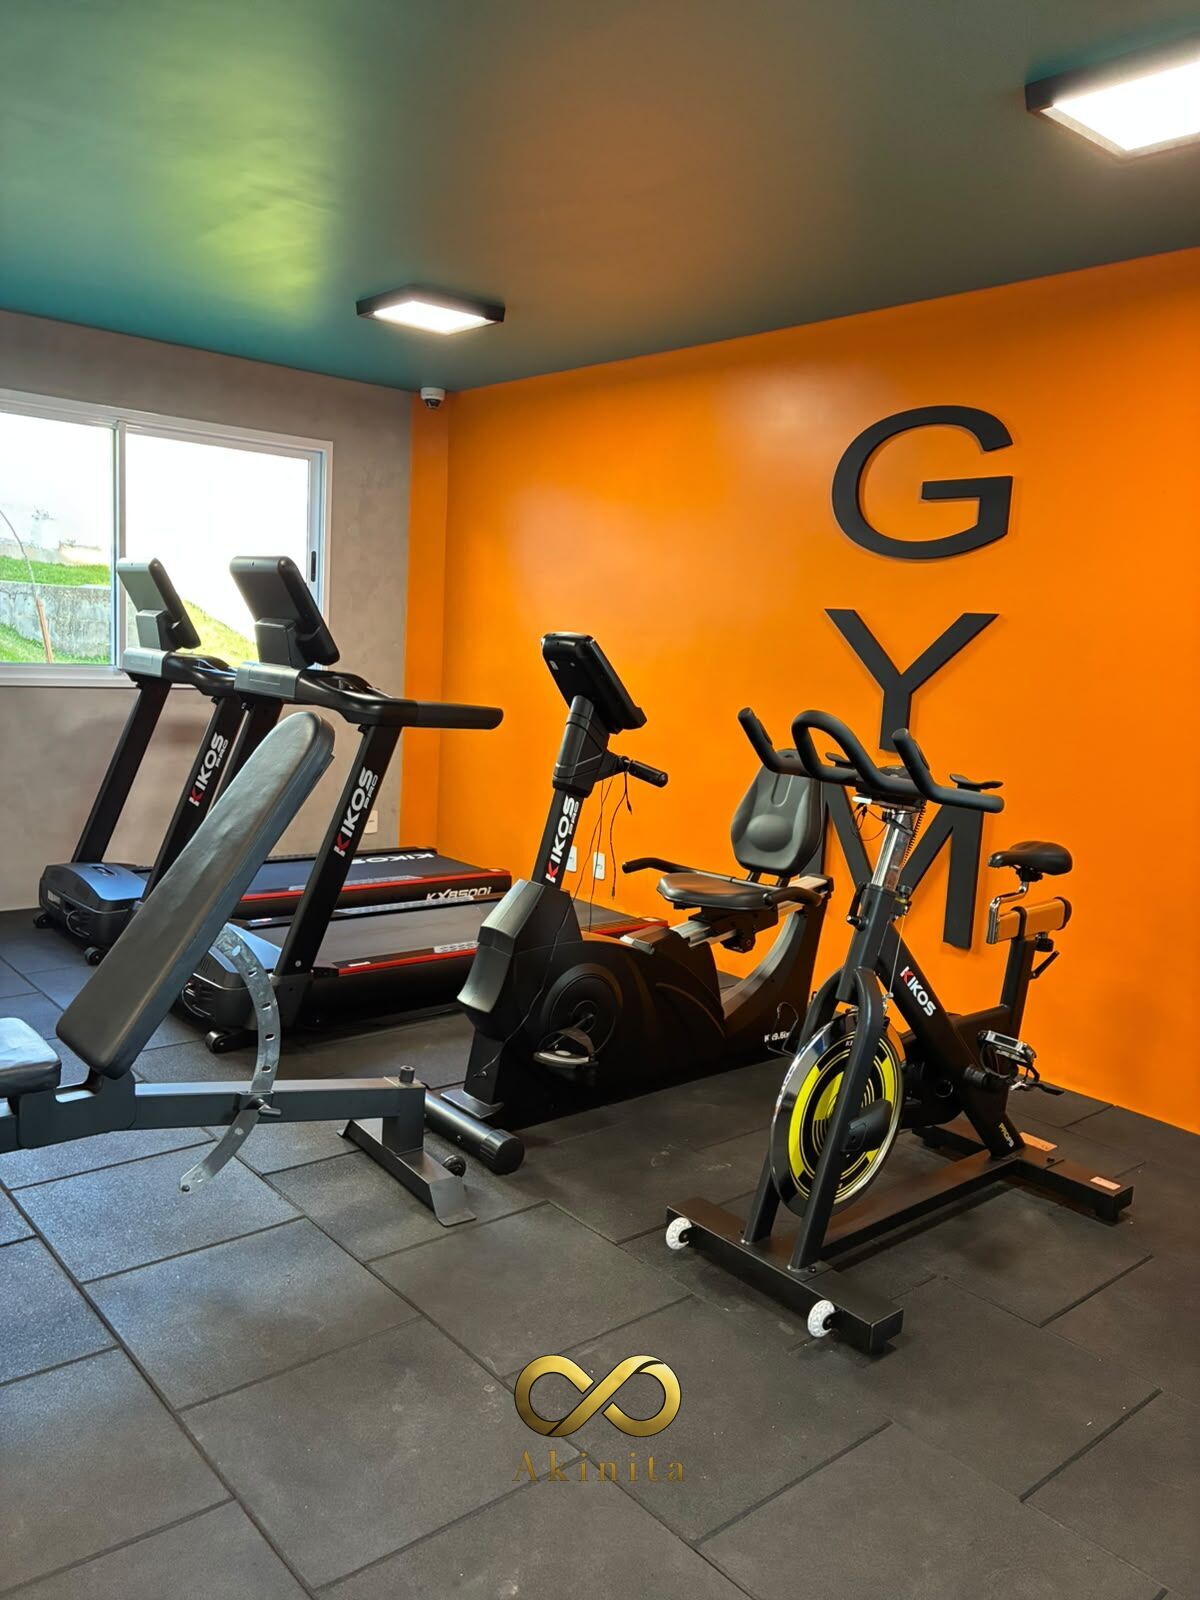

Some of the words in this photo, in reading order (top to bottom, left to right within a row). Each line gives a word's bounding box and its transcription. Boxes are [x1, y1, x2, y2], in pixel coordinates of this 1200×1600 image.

[799, 405, 1013, 949] GYM
[189, 732, 224, 807] KIKOS
[215, 739, 229, 768] PRO
[333, 766, 373, 857] KIKOS
[364, 774, 379, 809] PRO
[545, 794, 575, 884] KIKOS
[900, 966, 937, 1017] KIKOS
